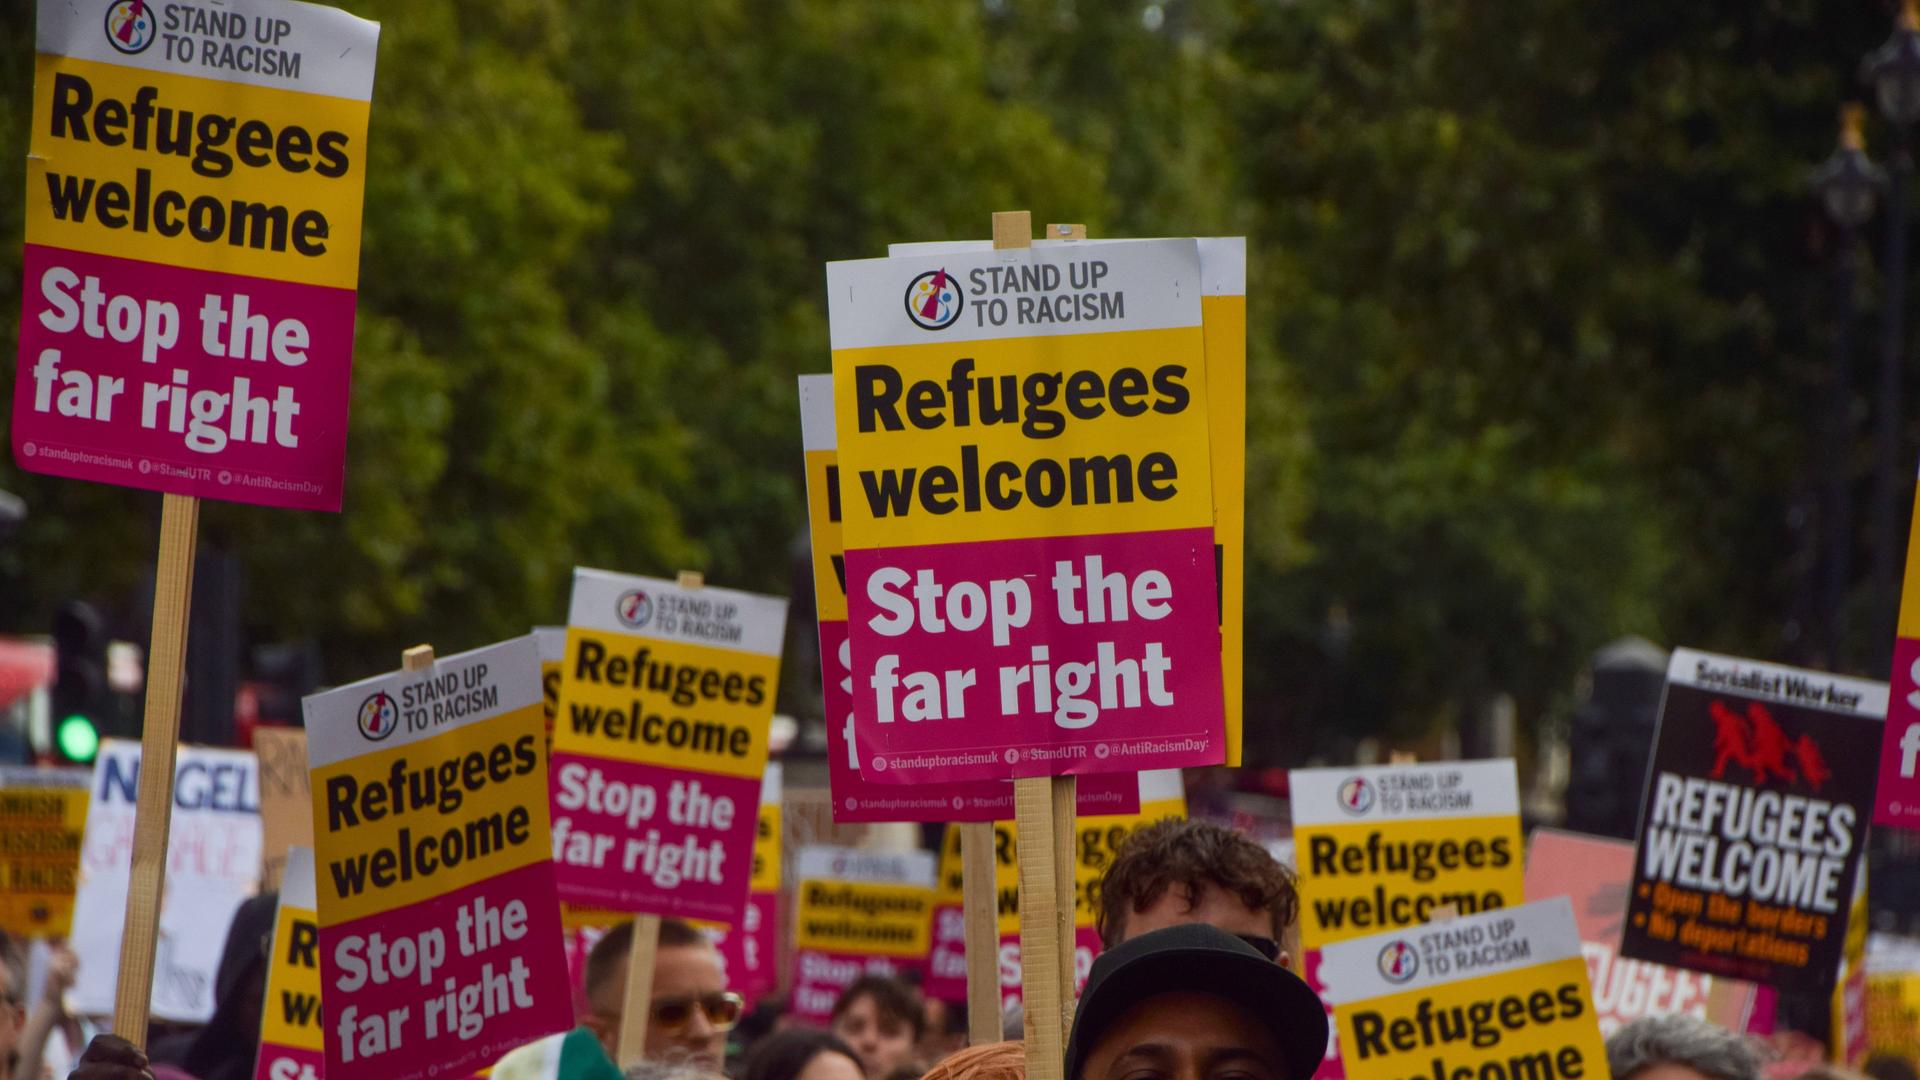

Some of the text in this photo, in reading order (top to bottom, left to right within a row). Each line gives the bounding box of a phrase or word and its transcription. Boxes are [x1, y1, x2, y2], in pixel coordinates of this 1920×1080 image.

[162, 33, 301, 79] TO RACISM
[164, 4, 291, 46] STAND UP
[51, 72, 349, 178] Refugees
[46, 168, 329, 257] welcome
[969, 260, 1108, 295] STAND UP
[971, 291, 1125, 327] TO RACISM
[38, 266, 310, 366] Stop the
[33, 349, 300, 454] far right
[854, 358, 1190, 439] Refugees
[38, 444, 134, 471] standuptoracismuk
[233, 474, 323, 495] @AntiRacismDay
[859, 445, 1179, 518] welcome
[656, 594, 738, 620] STAND UP
[656, 616, 743, 643] TO RACISM
[866, 566, 1033, 646] Stop
[1052, 554, 1172, 625] the
[402, 663, 489, 710] STAND UP
[576, 638, 767, 707] Refugees
[870, 654, 976, 723] far
[999, 642, 1174, 729] right
[1695, 660, 1863, 709] Socialist Worker
[403, 684, 498, 733] TO RACISM
[570, 700, 751, 758] welcome
[101, 754, 260, 814] NGEL
[327, 734, 537, 832] Refugees
[890, 739, 1205, 769] standuptoracismuk @StandUTR @AntiRacismDay
[1376, 772, 1463, 791] STAND UP
[556, 762, 657, 828] Stop
[666, 780, 735, 831] the
[1380, 792, 1473, 813] TO RACISM
[1651, 771, 1857, 858] REFUGEES
[330, 804, 531, 899] welcome
[550, 816, 726, 889] far right
[1308, 831, 1512, 882] Refugees
[1643, 825, 1846, 913] WELCOME
[334, 923, 446, 993] Stop
[456, 895, 529, 958] the
[1419, 917, 1516, 955] STAND UP
[1423, 938, 1532, 976] TO RACISM
[338, 1000, 410, 1063] far
[425, 956, 534, 1040] right
[1352, 982, 1585, 1061] Refugees
